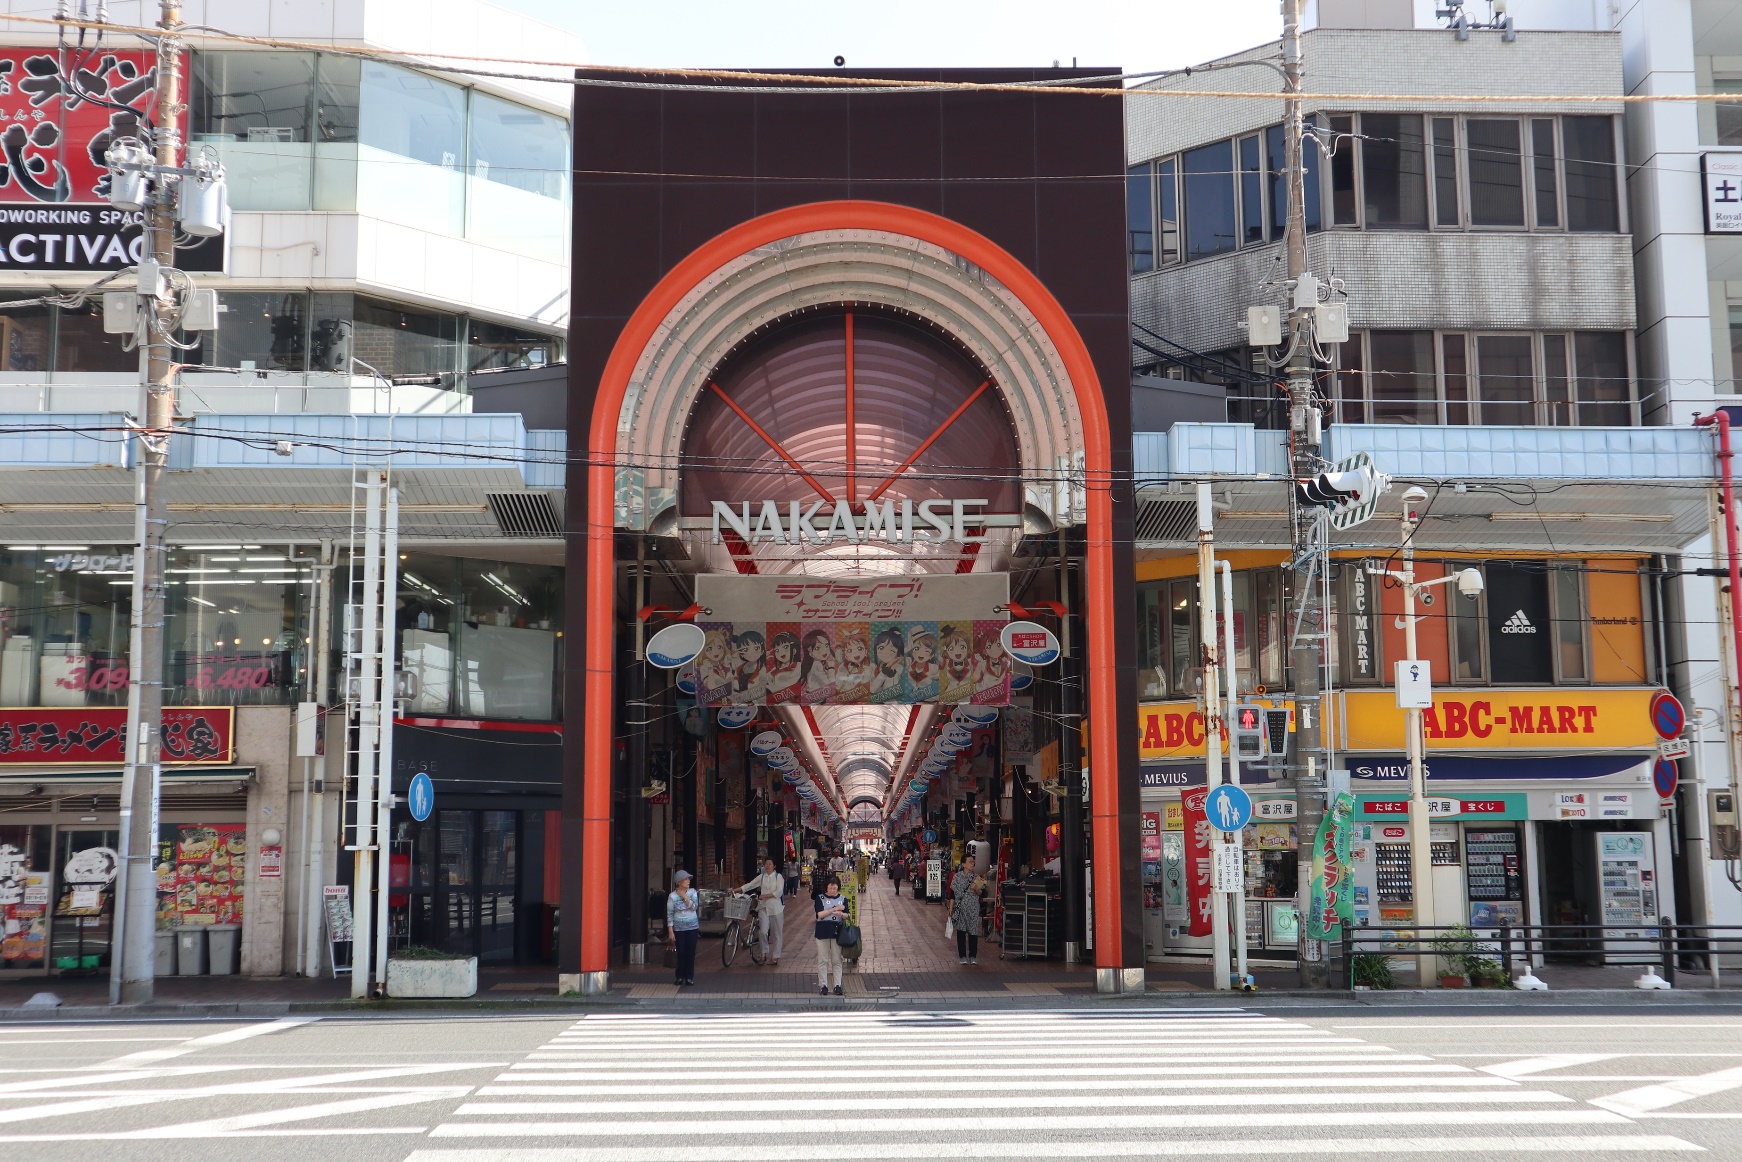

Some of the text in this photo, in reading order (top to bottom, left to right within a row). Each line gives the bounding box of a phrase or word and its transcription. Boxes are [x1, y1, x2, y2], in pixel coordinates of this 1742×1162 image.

[1714, 180, 1742, 203] 土
[98, 210, 144, 225] SPAC
[711, 499, 989, 545] NAKAMISE
[1591, 616, 1628, 625] Timberland
[1501, 624, 1537, 634] adidas
[773, 688, 796, 702] DIA
[397, 760, 438, 772] BASE
[1377, 766, 1430, 778] MEVS
[1144, 773, 1188, 784] MEVIUS
[1262, 804, 1293, 815] 富沢屋
[1375, 802, 1402, 811] たばこ
[1428, 802, 1451, 813] 沢屋
[1468, 803, 1495, 811] 宝くじ
